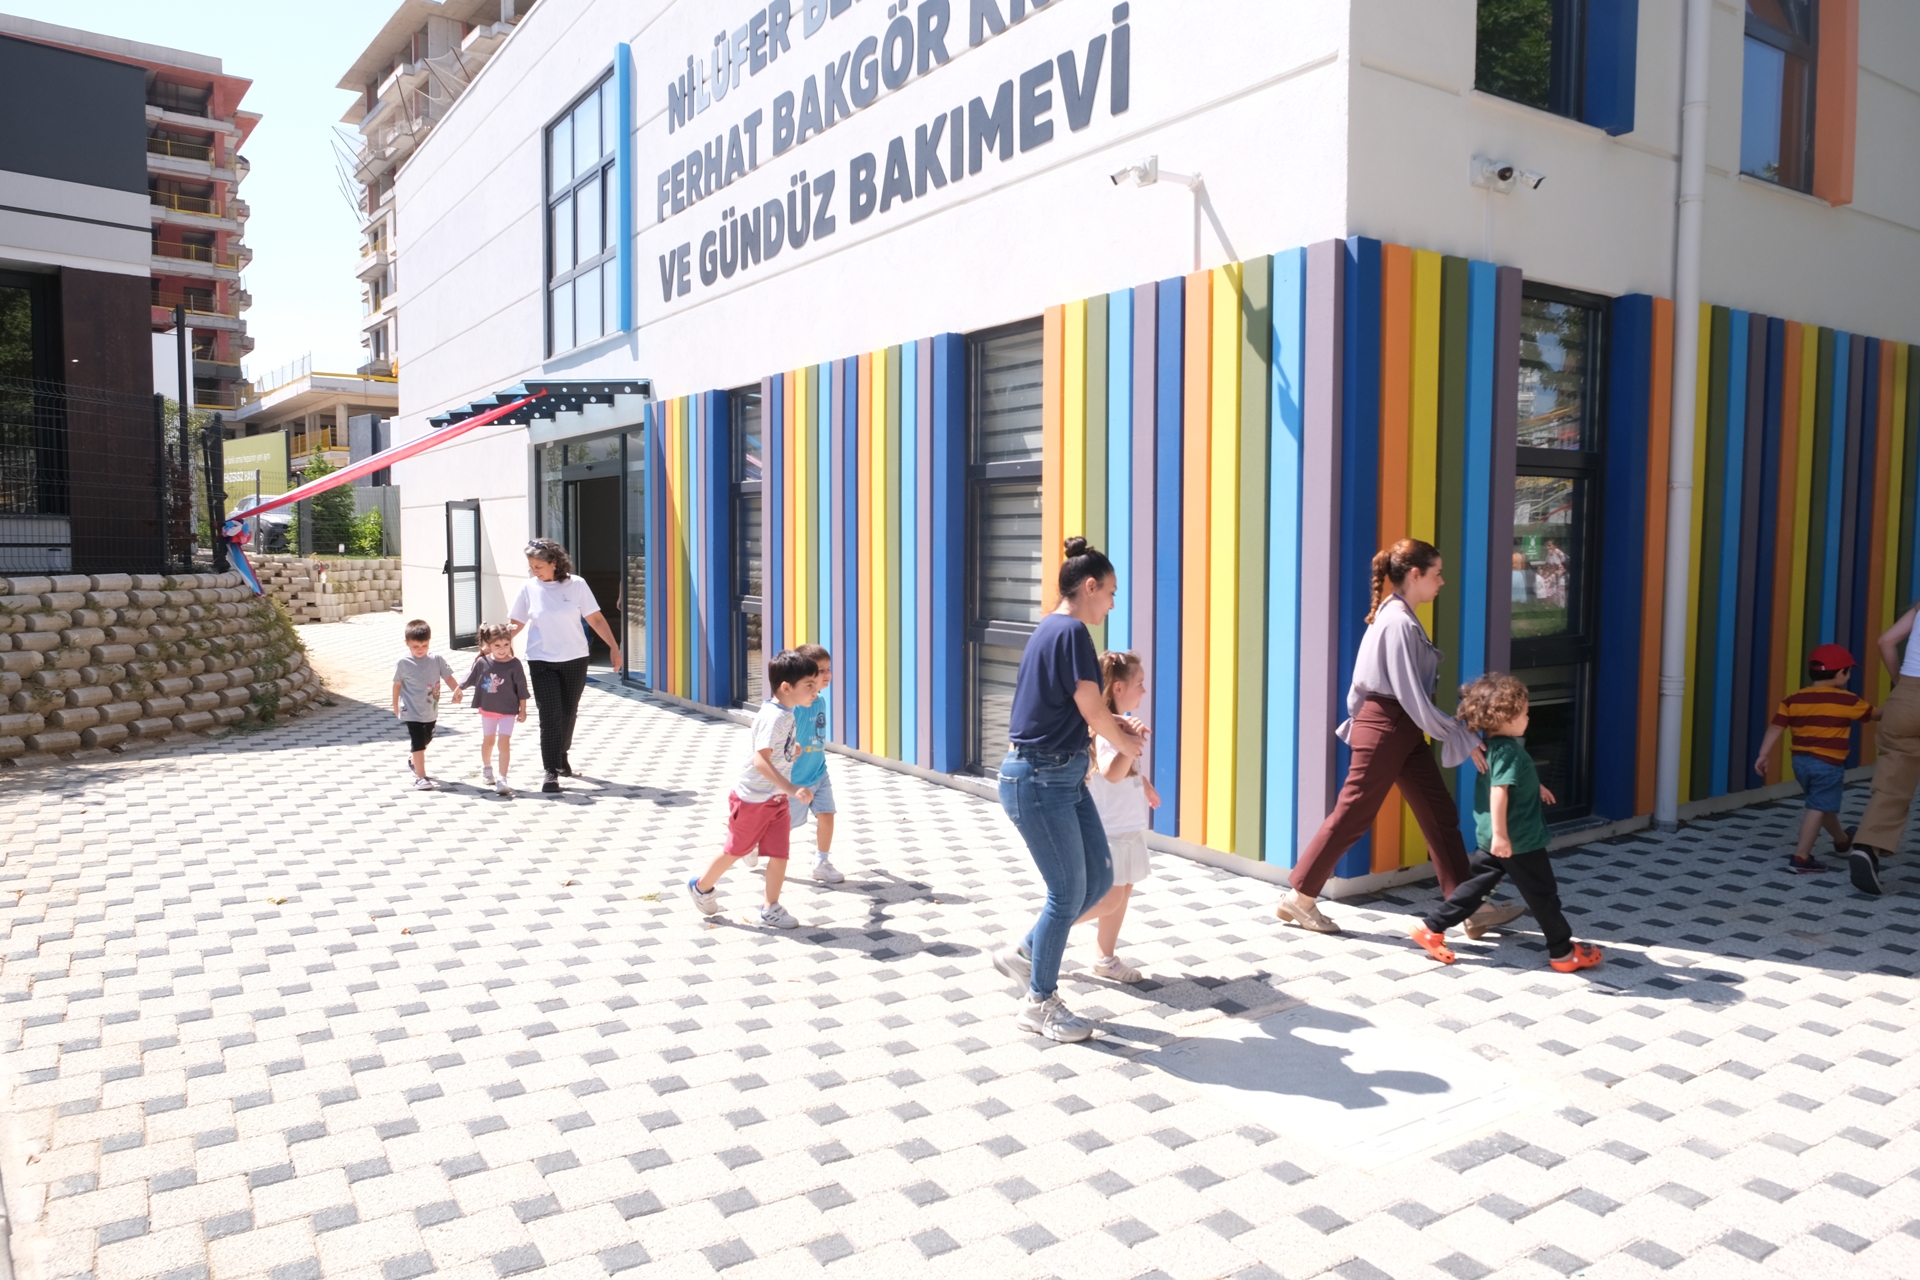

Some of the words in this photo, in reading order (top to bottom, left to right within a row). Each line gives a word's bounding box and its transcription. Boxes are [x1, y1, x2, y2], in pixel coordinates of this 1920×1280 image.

[657, 108, 762, 223] FERHAT
[773, 0, 950, 157] BAKGÖR
[659, 242, 691, 302] VE
[699, 170, 836, 287] GÜNDÜZ
[850, 1, 1130, 225] BAKIMEVİ
[668, 0, 791, 135] NİLÜFER
